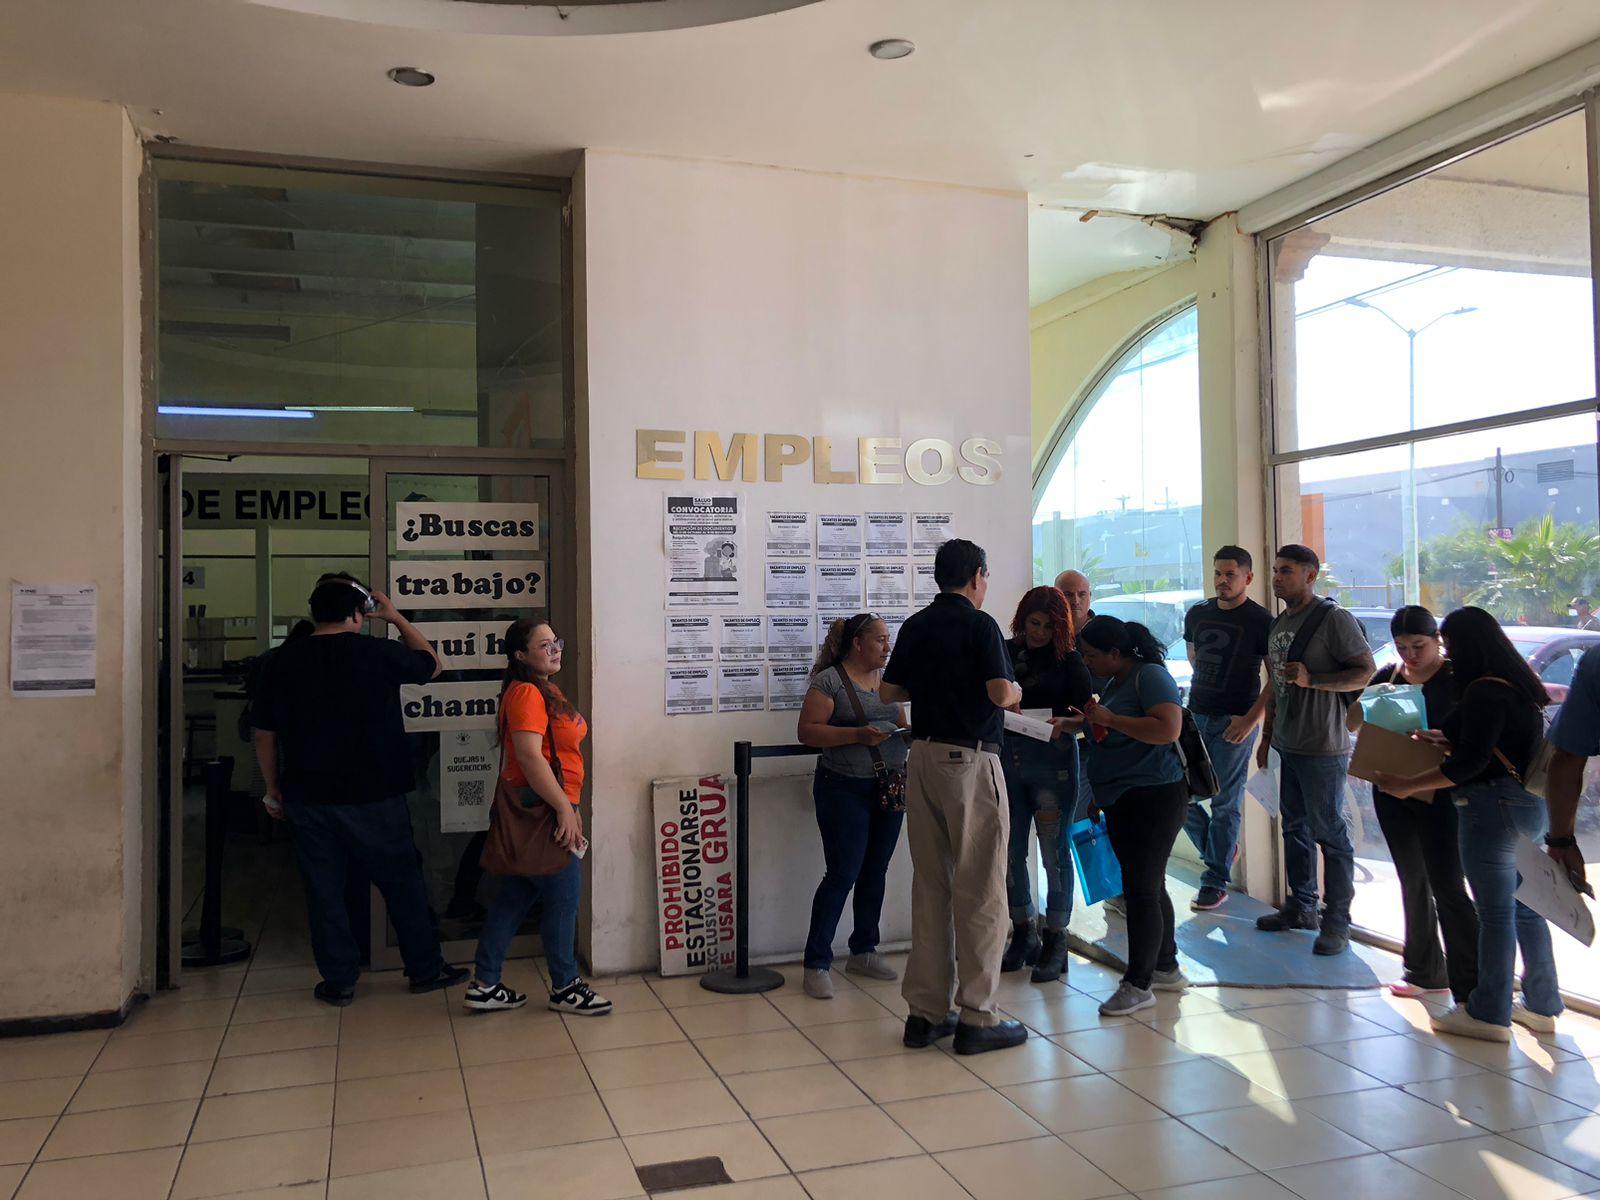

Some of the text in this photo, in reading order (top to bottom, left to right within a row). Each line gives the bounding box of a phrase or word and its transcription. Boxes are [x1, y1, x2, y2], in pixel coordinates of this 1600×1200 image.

[635, 428, 1003, 486] EMPLEOS
[235, 490, 369, 520] EMPLE
[402, 513, 534, 542] ¿Buscas
[396, 572, 541, 600] trabajo?
[404, 693, 500, 718] cham
[447, 764, 492, 772] SUGERENCIAS
[453, 756, 479, 764] QUEJAS
[698, 774, 729, 864] GRUA
[660, 821, 684, 950] PROHIBIDO
[680, 788, 706, 968] ESTACIONARSE
[716, 872, 734, 942] USARA
